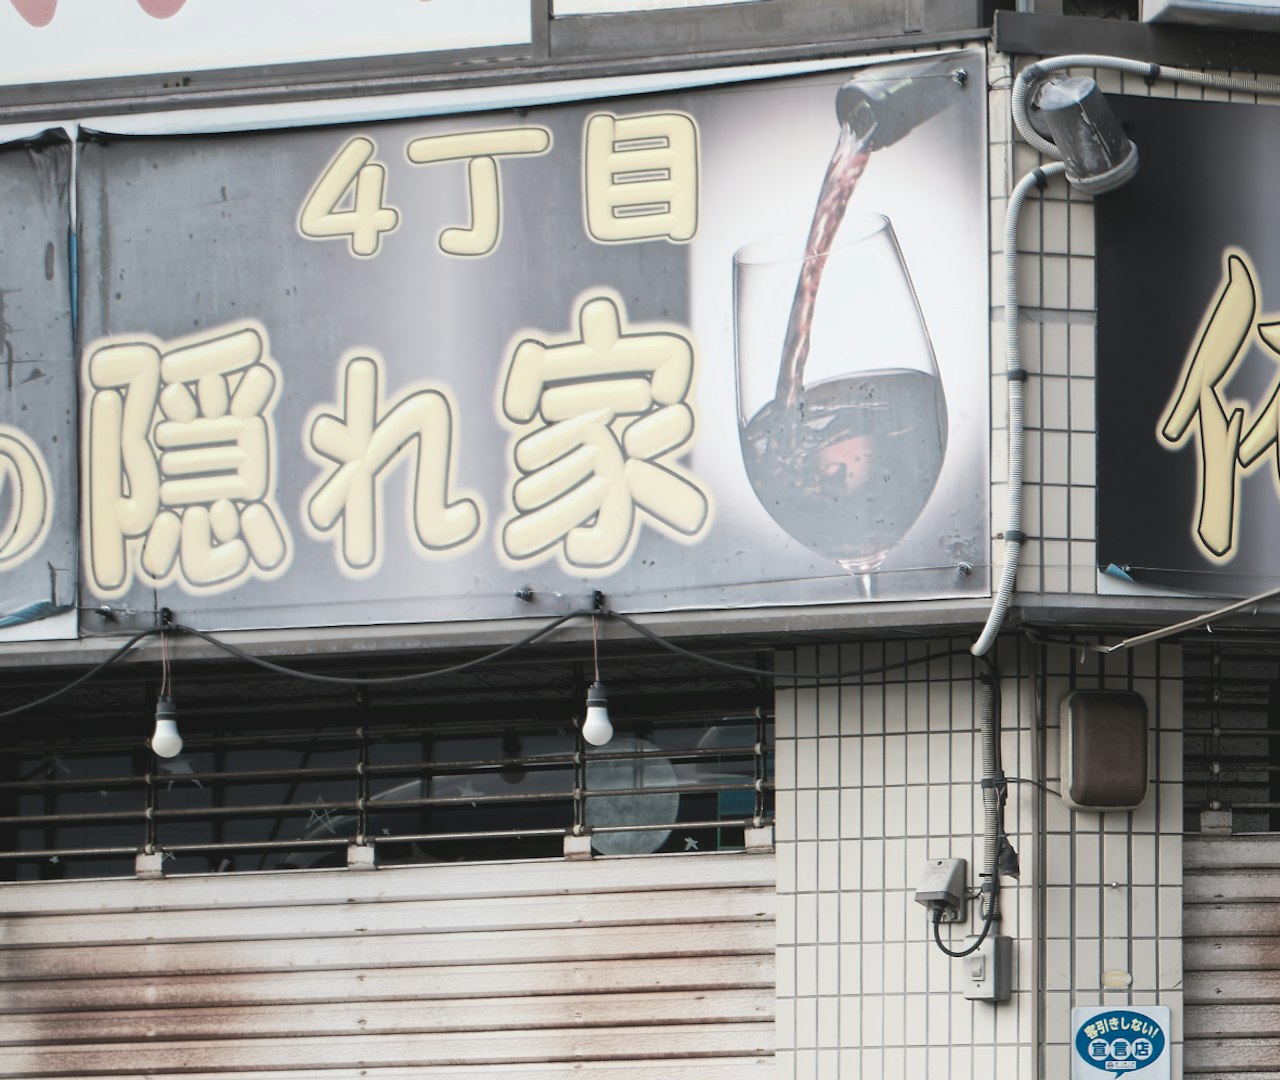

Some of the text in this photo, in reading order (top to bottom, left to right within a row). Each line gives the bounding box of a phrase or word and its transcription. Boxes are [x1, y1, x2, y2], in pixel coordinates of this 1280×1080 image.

[298, 110, 699, 257] 4丁目
[1091, 1041, 1150, 1057] 宣言店
